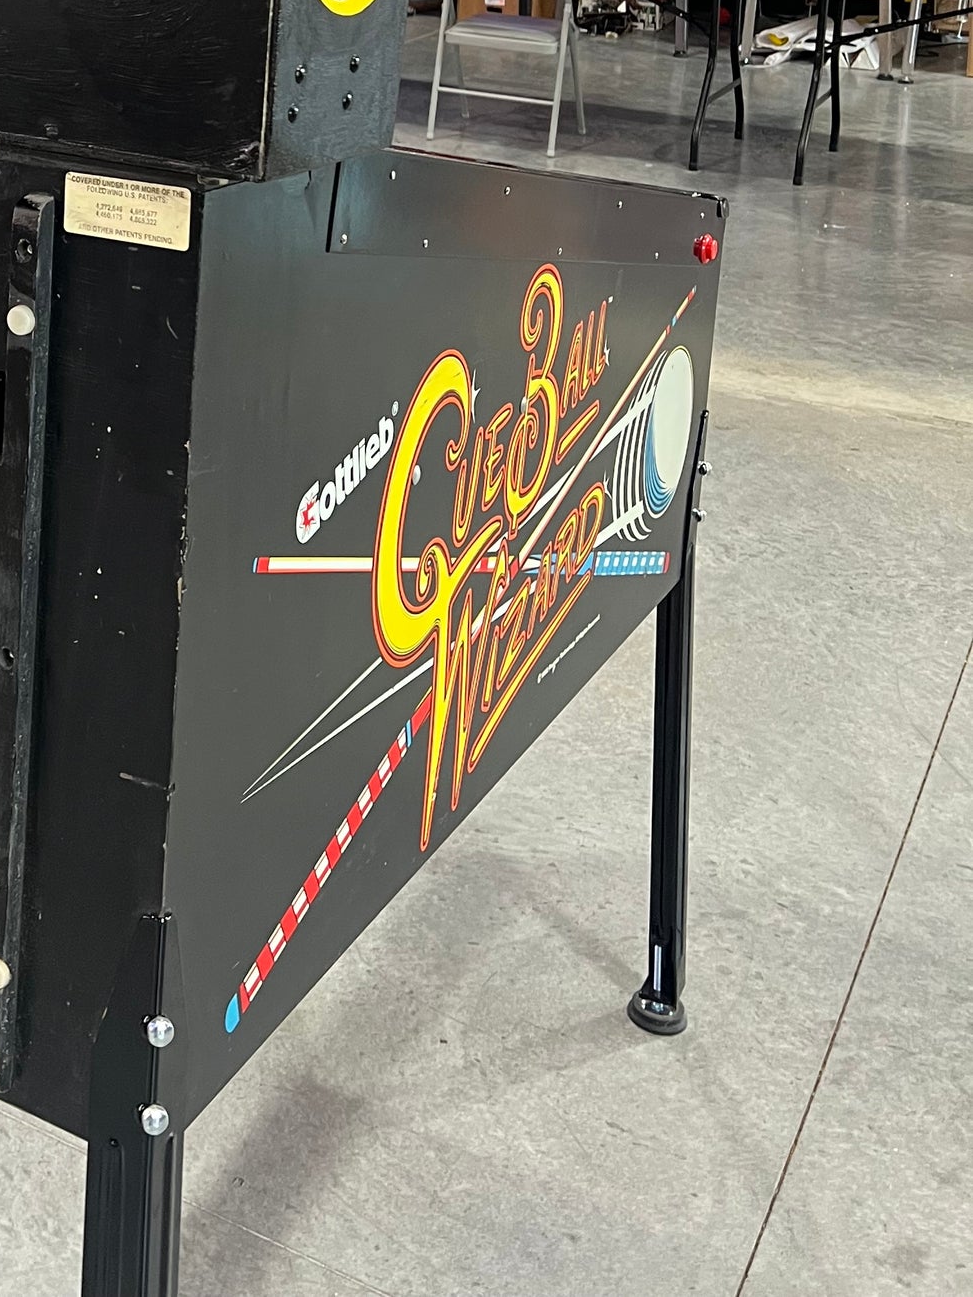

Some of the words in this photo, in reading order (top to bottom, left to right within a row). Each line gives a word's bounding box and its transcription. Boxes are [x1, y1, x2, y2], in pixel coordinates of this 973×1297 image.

[71, 175, 101, 185] COVERED
[102, 179, 124, 189] UNDER
[141, 185, 160, 194] MORE
[161, 188, 171, 196] OF
[172, 189, 185, 198] THE
[86, 185, 123, 197] FOLLOWING
[92, 225, 113, 235] OTHER
[114, 228, 143, 239] PATENTS
[504, 263, 610, 540] BALL
[296, 415, 395, 543] Gottlieb
[417, 481, 605, 851] WIZARD
